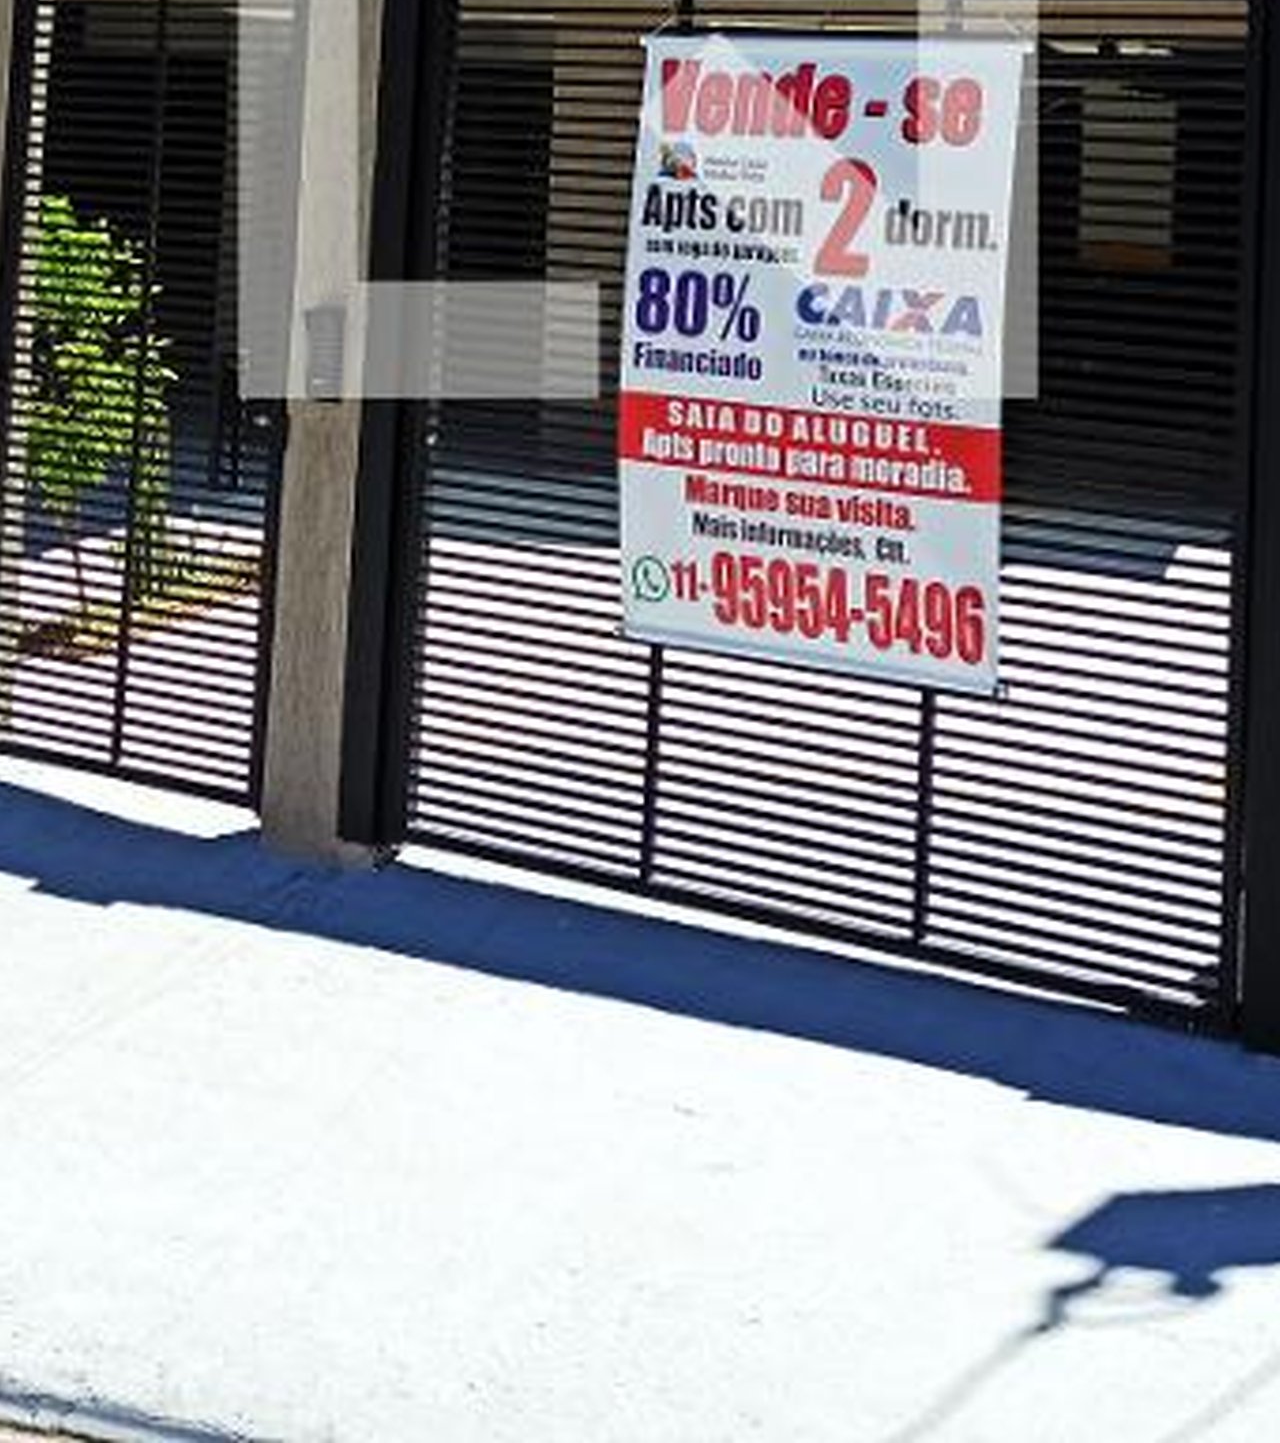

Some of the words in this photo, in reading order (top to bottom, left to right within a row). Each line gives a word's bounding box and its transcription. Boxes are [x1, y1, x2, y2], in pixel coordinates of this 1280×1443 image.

[661, 57, 853, 141] Vende
[902, 77, 982, 146] se
[641, 184, 717, 233] Apts
[724, 195, 803, 236] com
[812, 158, 877, 277] 2
[885, 199, 998, 251] dorm.
[635, 267, 761, 342] 80%
[797, 282, 982, 336] CAIXA
[633, 342, 762, 380] Financiado
[811, 386, 854, 409] Use
[859, 394, 901, 414] seu
[642, 427, 694, 459] Apts
[698, 436, 781, 472] pronto
[785, 446, 844, 478] para
[668, 400, 735, 432] SAIA
[743, 411, 782, 438] DO
[792, 415, 941, 456] ALUGUEL.
[685, 475, 777, 514] Marque
[785, 491, 833, 521] sua
[837, 497, 915, 531] visita.
[693, 512, 738, 541] Mais
